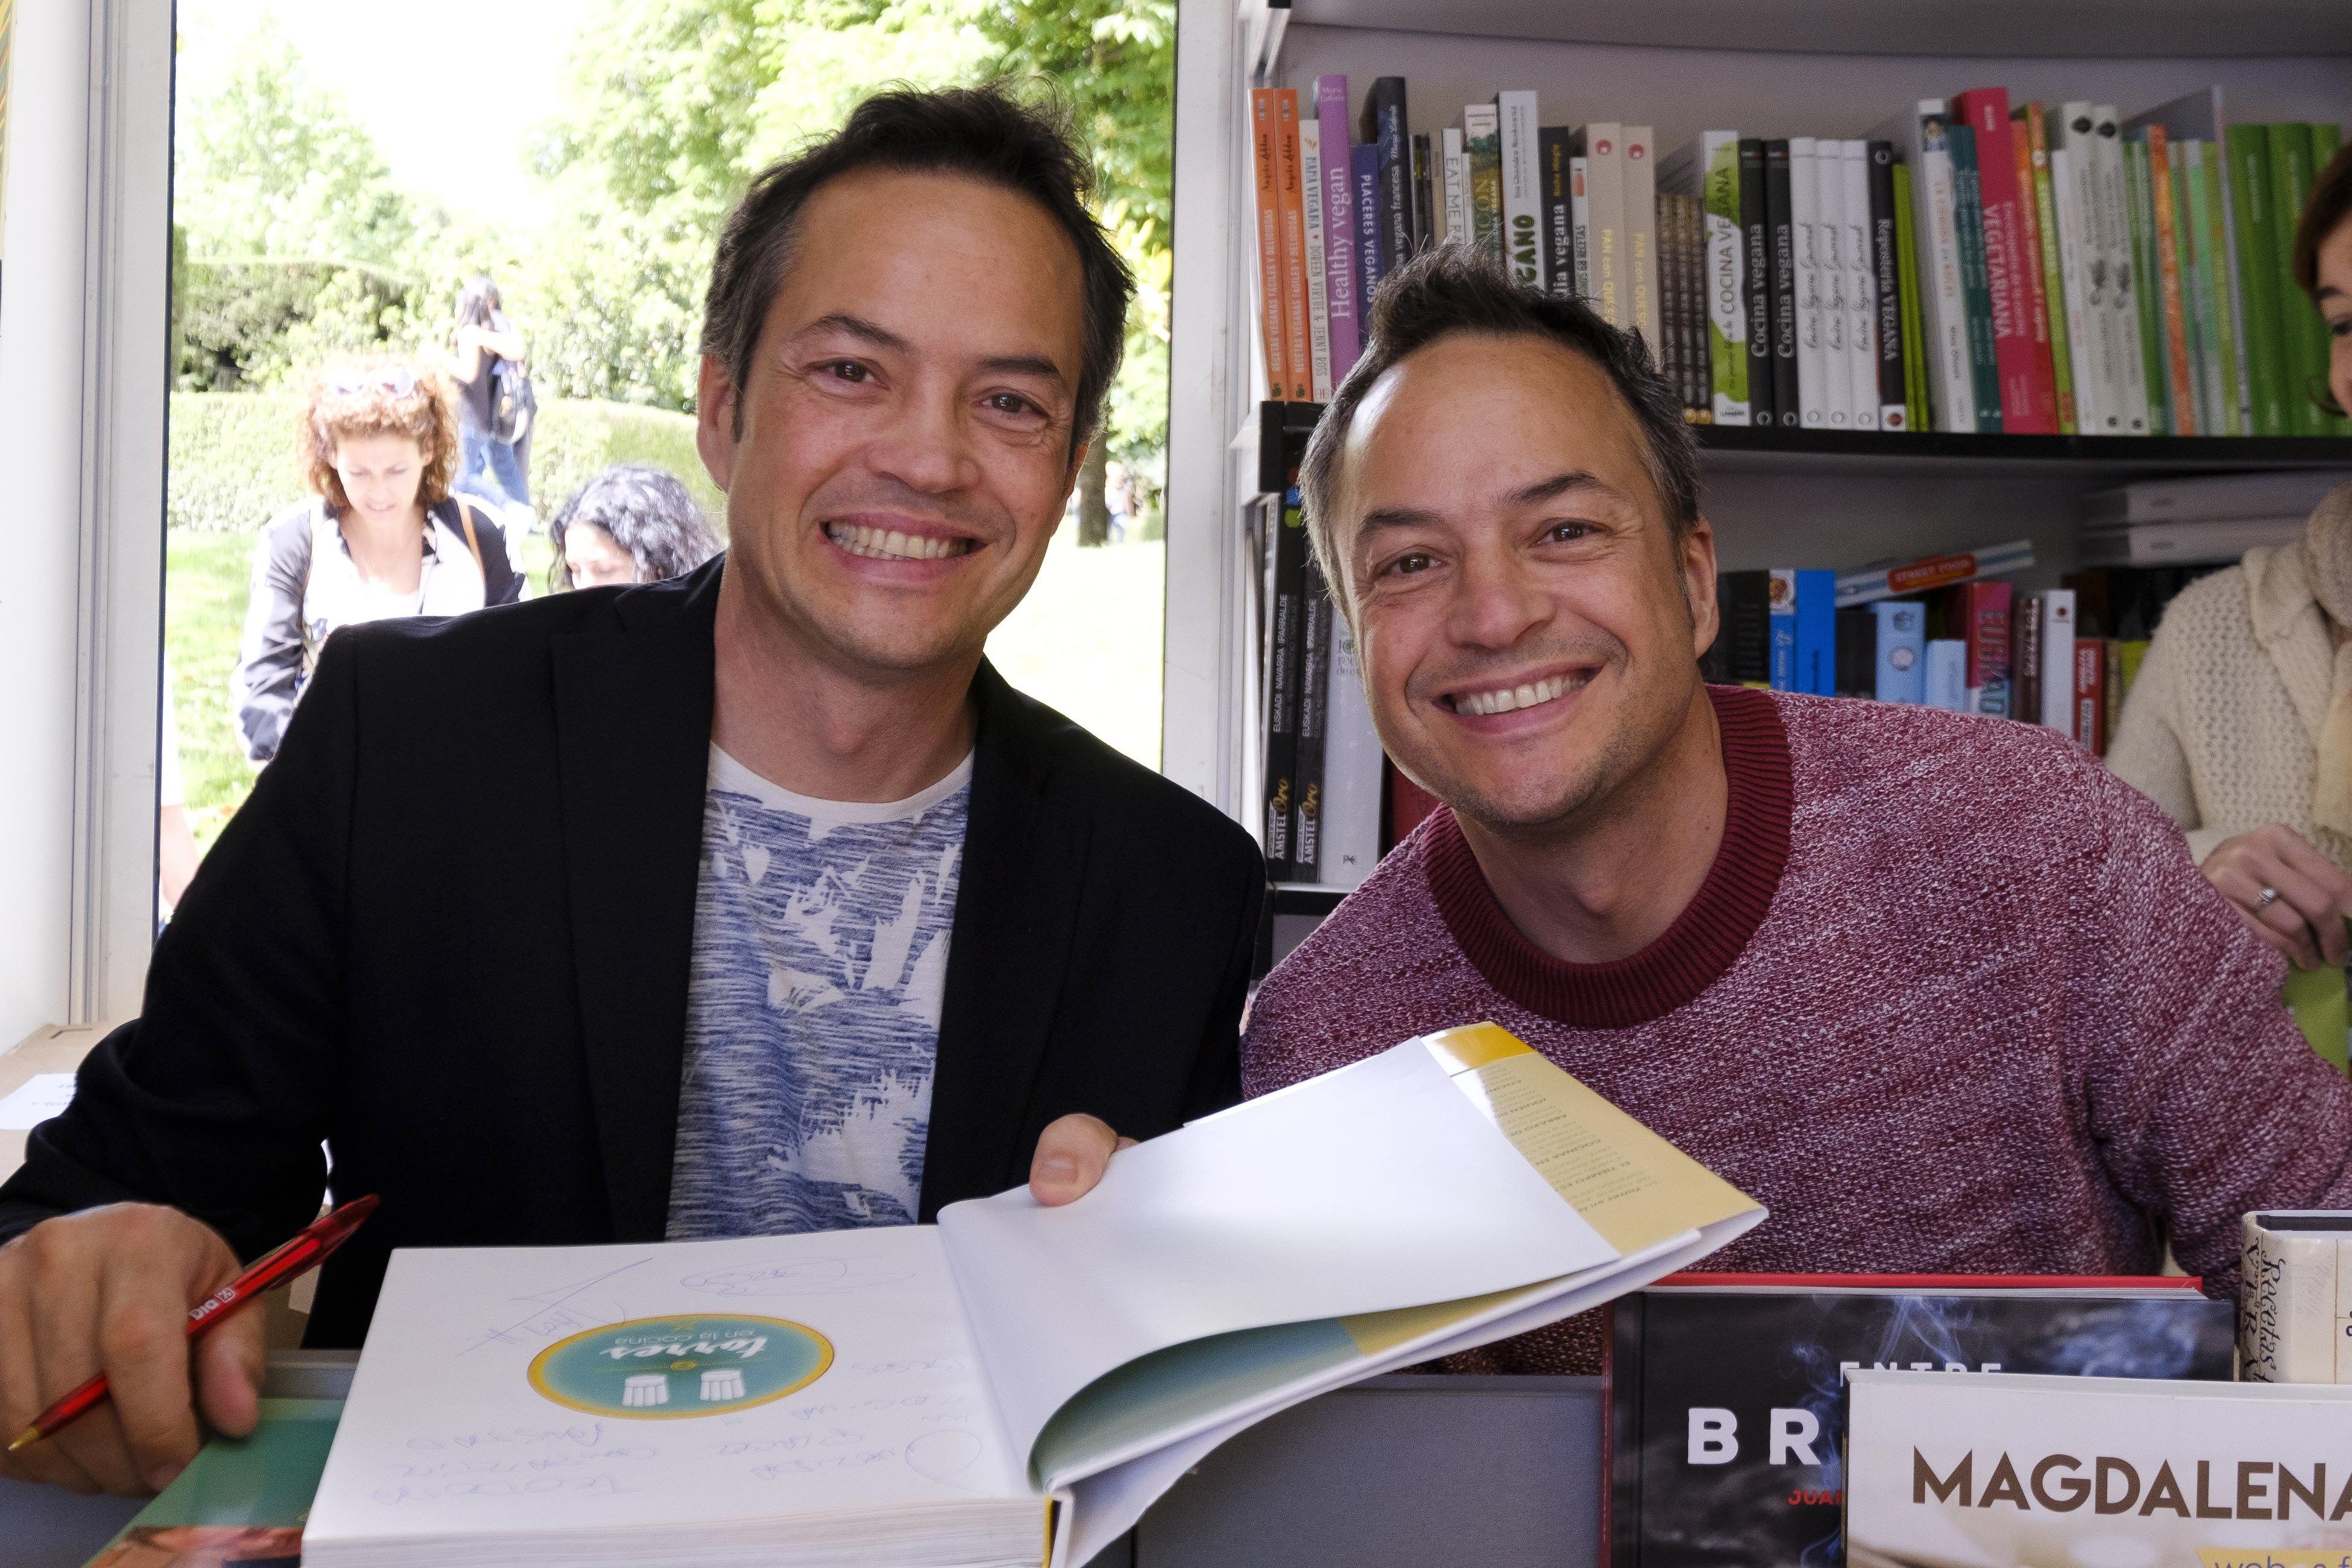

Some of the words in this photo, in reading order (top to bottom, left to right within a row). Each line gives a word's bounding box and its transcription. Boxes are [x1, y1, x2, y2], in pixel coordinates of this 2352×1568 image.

[1390, 165, 1401, 209] francesa
[1446, 157, 1461, 189] EAT
[1307, 186, 1320, 229] VEGANA
[1329, 166, 1349, 230] vegan
[1360, 174, 1374, 235] PLACERES
[1448, 194, 1461, 218] ME
[1715, 167, 1733, 242] VEGANA
[1391, 212, 1404, 250] vegana
[1552, 205, 1570, 266] vegana
[1576, 226, 1587, 258] RECETAS
[1601, 229, 1613, 253] PAN
[1634, 232, 1646, 258] PAN
[1310, 245, 1323, 277] DOREEN
[1327, 233, 1353, 318] Healthy
[1364, 239, 1376, 303] VEGANOS
[1748, 223, 1766, 290] vegana
[1774, 223, 1792, 290] vegana
[1982, 203, 2012, 338] VEGETARIANA
[1313, 281, 1324, 312] VIRTUE
[1719, 247, 1736, 315] COCINA
[1269, 298, 1280, 335] VEGANAS
[1292, 299, 1303, 337] VEGANAS
[1751, 294, 1769, 358] Cocina
[1777, 294, 1795, 358] Cocina
[1881, 296, 1897, 361] VEGANA
[1315, 326, 1326, 354] JENNY
[1316, 357, 1327, 376] ROSS
[1277, 593, 1288, 644] IPARRALDE
[1306, 598, 1317, 649] IPARRALDE
[1276, 648, 1285, 689] NAVARRA
[1304, 653, 1314, 694] NAVARRA
[1978, 610, 2008, 715] EUSKAD
[1273, 694, 1283, 733] EUSKADI
[1302, 698, 1312, 738] EUSKADI
[1272, 777, 1290, 814] Oro
[1301, 782, 1320, 818] Oro
[1274, 814, 1286, 859] AMSTEL
[1303, 818, 1316, 864] AMSTEL
[2259, 1250, 2286, 1371] Recetas
[600, 1335, 770, 1361] torres
[615, 1334, 694, 1346] cocina
